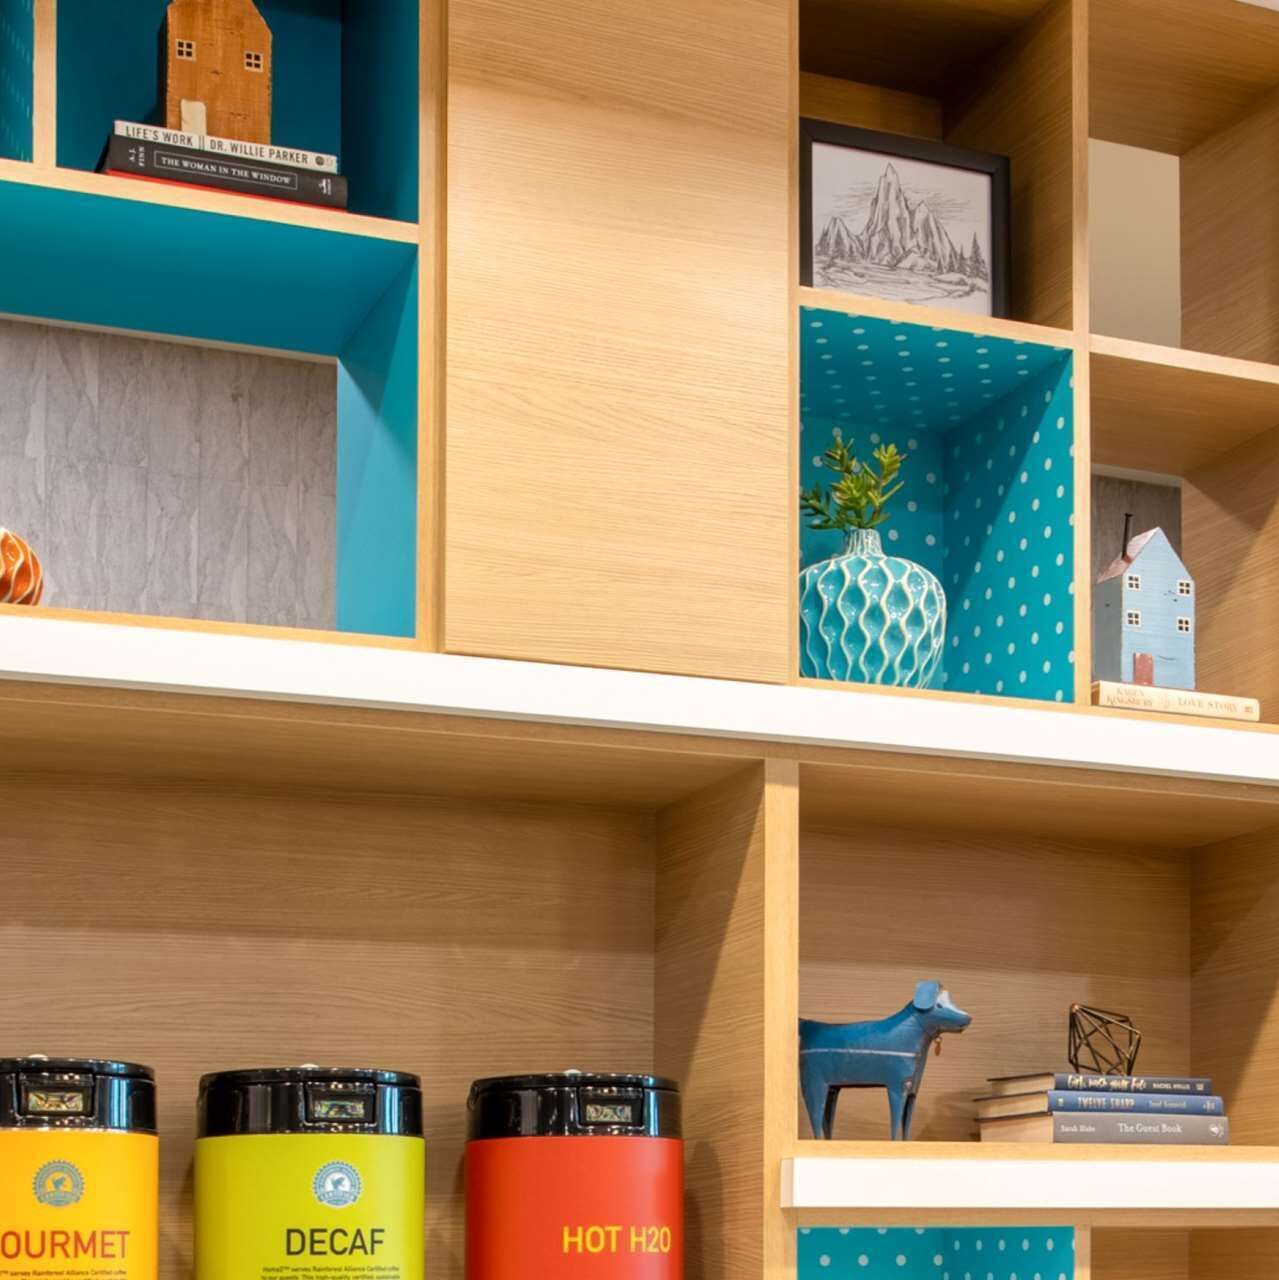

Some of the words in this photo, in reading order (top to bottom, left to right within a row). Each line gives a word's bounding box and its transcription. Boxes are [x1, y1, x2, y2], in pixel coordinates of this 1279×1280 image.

[125, 125, 159, 141] LIFE'S
[162, 131, 193, 147] WORK
[210, 139, 227, 152] DR.
[230, 142, 265, 158] WILLIE
[268, 148, 308, 164] PARKER
[161, 156, 180, 168] THE
[182, 160, 217, 172] WOMAN
[218, 165, 230, 174] IN
[232, 167, 250, 178] THE
[251, 170, 291, 185] WINDOW
[1117, 1122, 1135, 1133] The
[1136, 1122, 1160, 1134] Guest
[1161, 1123, 1183, 1134] Book
[285, 1228, 386, 1256] DECAF
[562, 1225, 623, 1254] HOT
